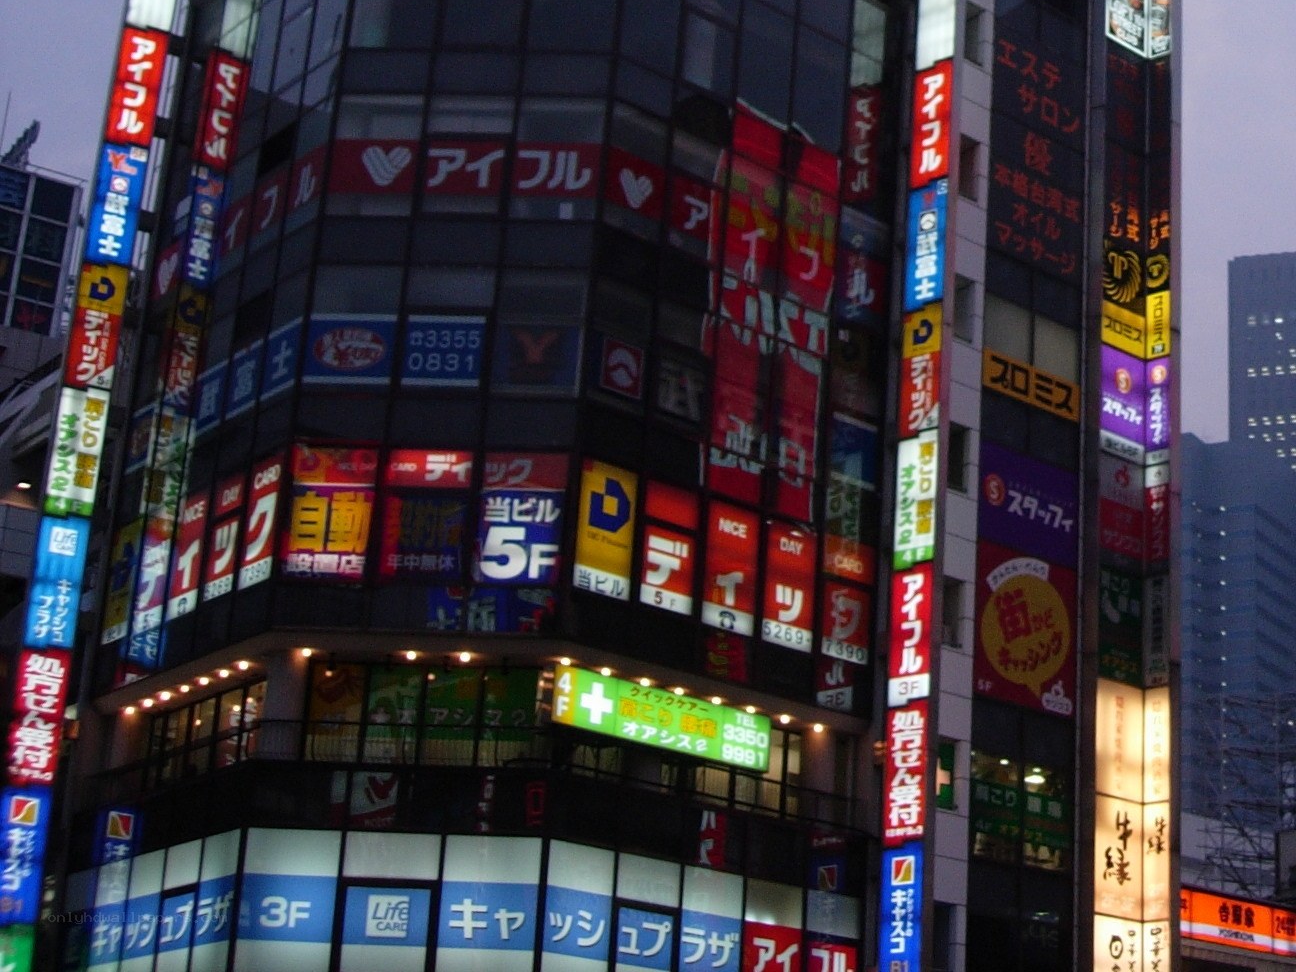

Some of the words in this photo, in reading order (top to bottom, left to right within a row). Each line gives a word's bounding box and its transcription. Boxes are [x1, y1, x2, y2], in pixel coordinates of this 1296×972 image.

[116, 35, 157, 135] アイフル
[921, 73, 945, 173] アイフル
[427, 148, 592, 191] アイフル
[225, 165, 316, 247] イフル
[77, 309, 108, 382] ディック
[1104, 314, 1143, 343] プロミス
[408, 352, 475, 372] 0831
[907, 354, 931, 430] ディック
[989, 355, 1073, 413] プロミス
[424, 453, 533, 484] ディック
[287, 490, 374, 554] 自動
[484, 496, 561, 524] 当ビル
[896, 462, 917, 546] オアシス2
[386, 553, 456, 572] 年中無休
[480, 525, 560, 580] 5F
[718, 517, 748, 540] NICE
[779, 536, 804, 557] DAY
[833, 554, 863, 576] CARD
[901, 548, 926, 562] 4F
[578, 568, 625, 597] 当ビル
[34, 595, 56, 639] プラザ
[898, 573, 925, 676] アイフル
[825, 637, 865, 663] 7390
[556, 671, 573, 717] 4F
[630, 686, 709, 714] クイックケアー
[898, 680, 920, 696] 3F
[622, 721, 709, 753] オアシス2
[722, 723, 768, 748] 3350
[735, 712, 758, 729] TEL
[721, 744, 765, 766] 9991
[887, 709, 925, 827] 処方せん受付
[91, 889, 236, 956] キャッシュプラザ
[259, 895, 312, 928] 3F
[371, 897, 410, 921] Life
[889, 889, 909, 954] キャスコ
[448, 897, 741, 968] キャッシュプラザ
